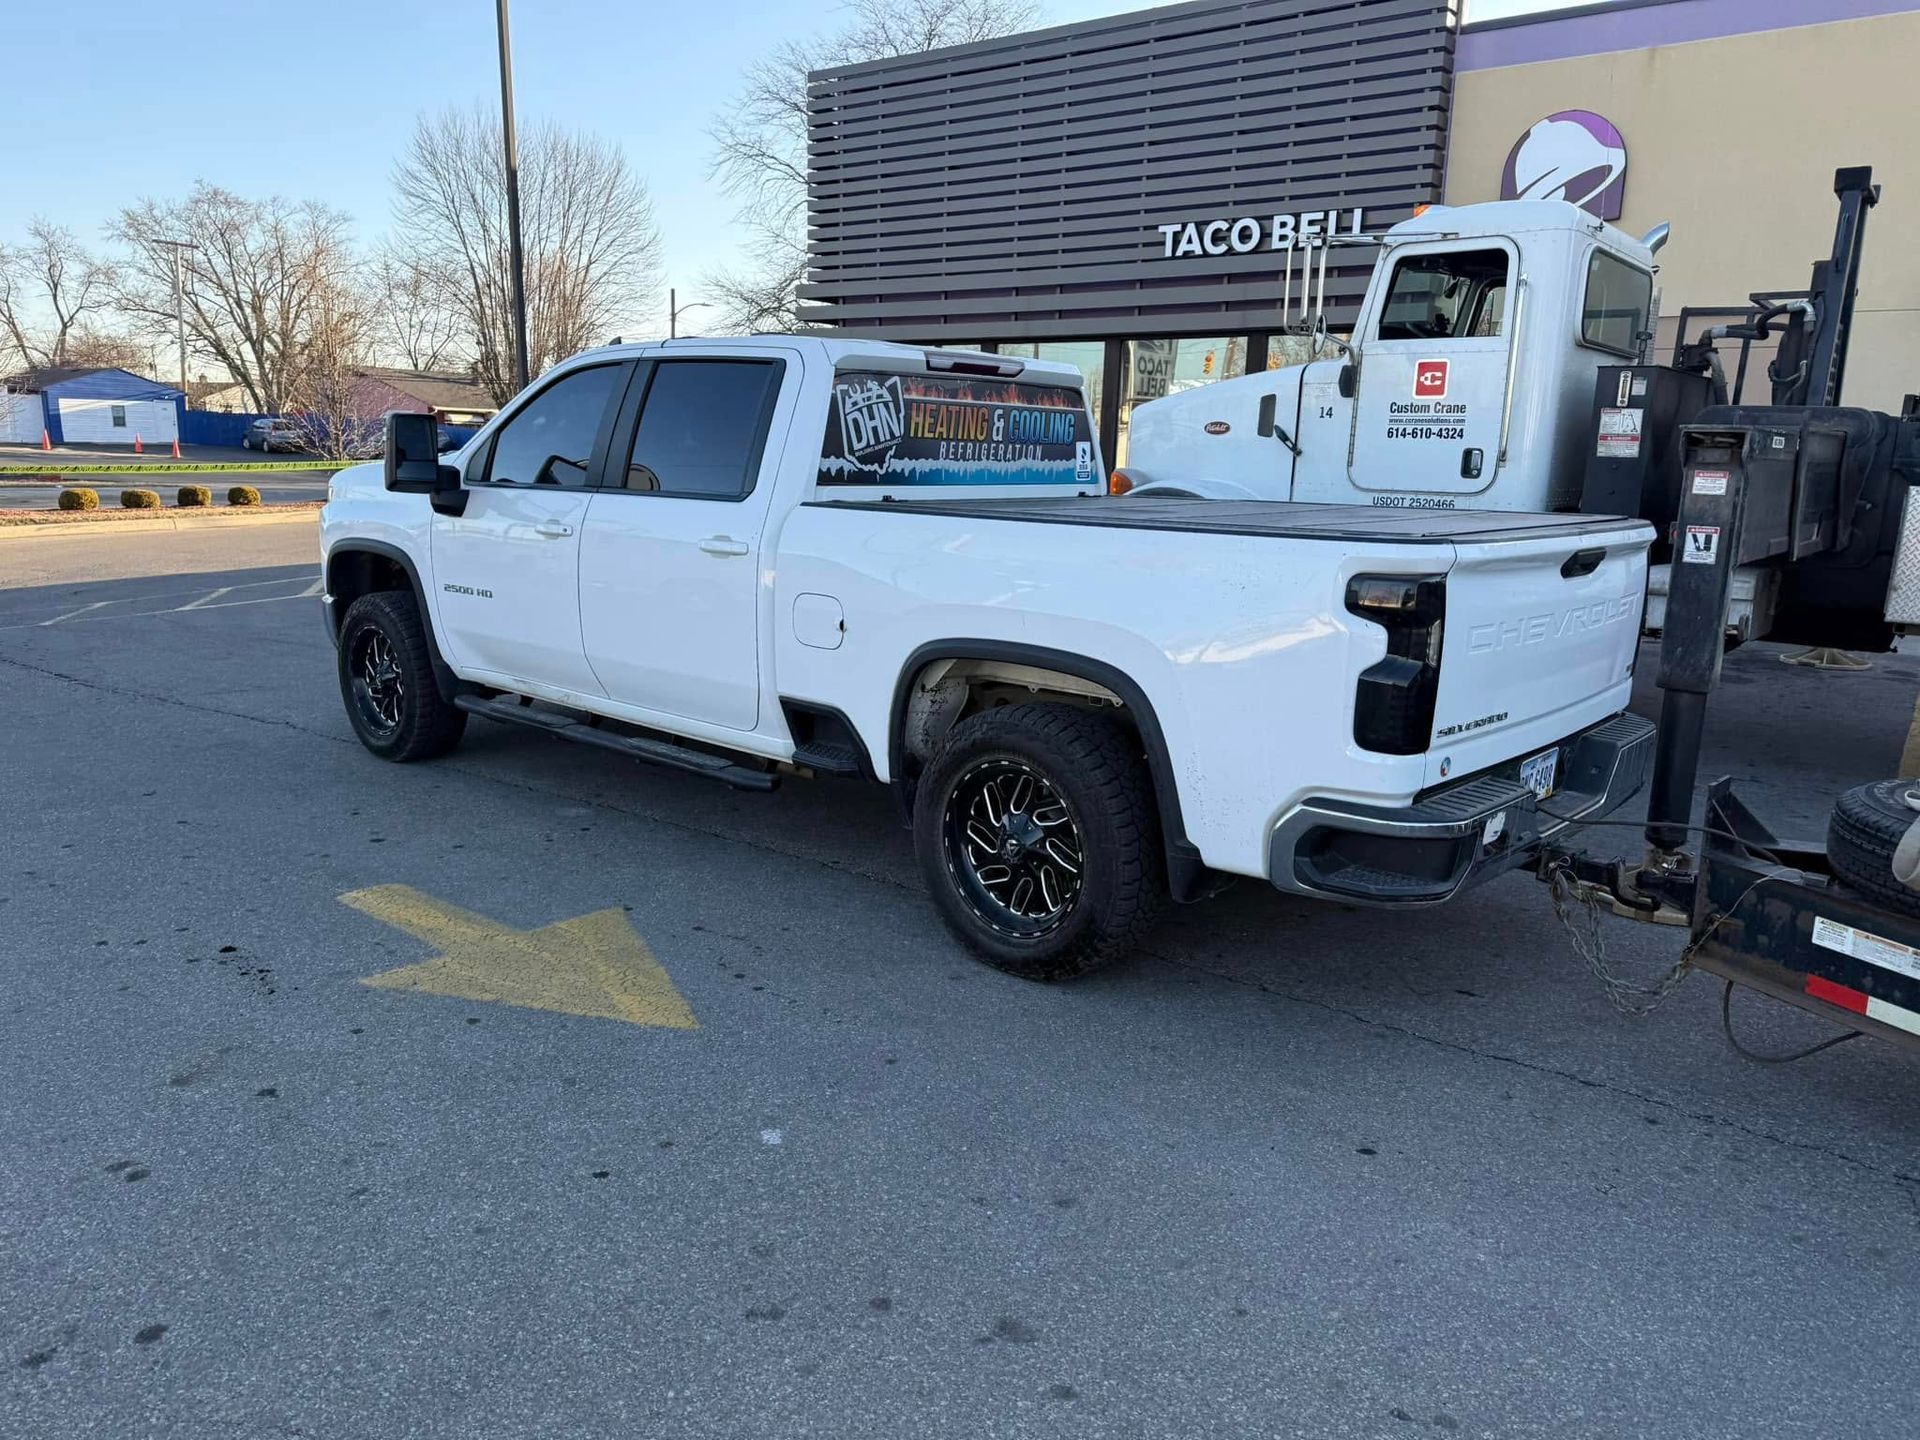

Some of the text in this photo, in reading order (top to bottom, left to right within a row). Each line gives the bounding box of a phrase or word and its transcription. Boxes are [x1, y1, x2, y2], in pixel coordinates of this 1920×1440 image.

[1158, 217, 1261, 257] TACO
[1319, 406, 1333, 418] 14
[1390, 402, 1466, 414] Custom Crane
[846, 401, 900, 451] DHN
[910, 402, 1075, 445] HEATING & COOLING
[1387, 427, 1464, 439] 614-610-4324
[940, 442, 1043, 460] REFRIGERATION
[1372, 496, 1455, 509] USDOT 2520466
[444, 583, 493, 598] 2500 HD
[1466, 592, 1640, 655] CHEVROLET
